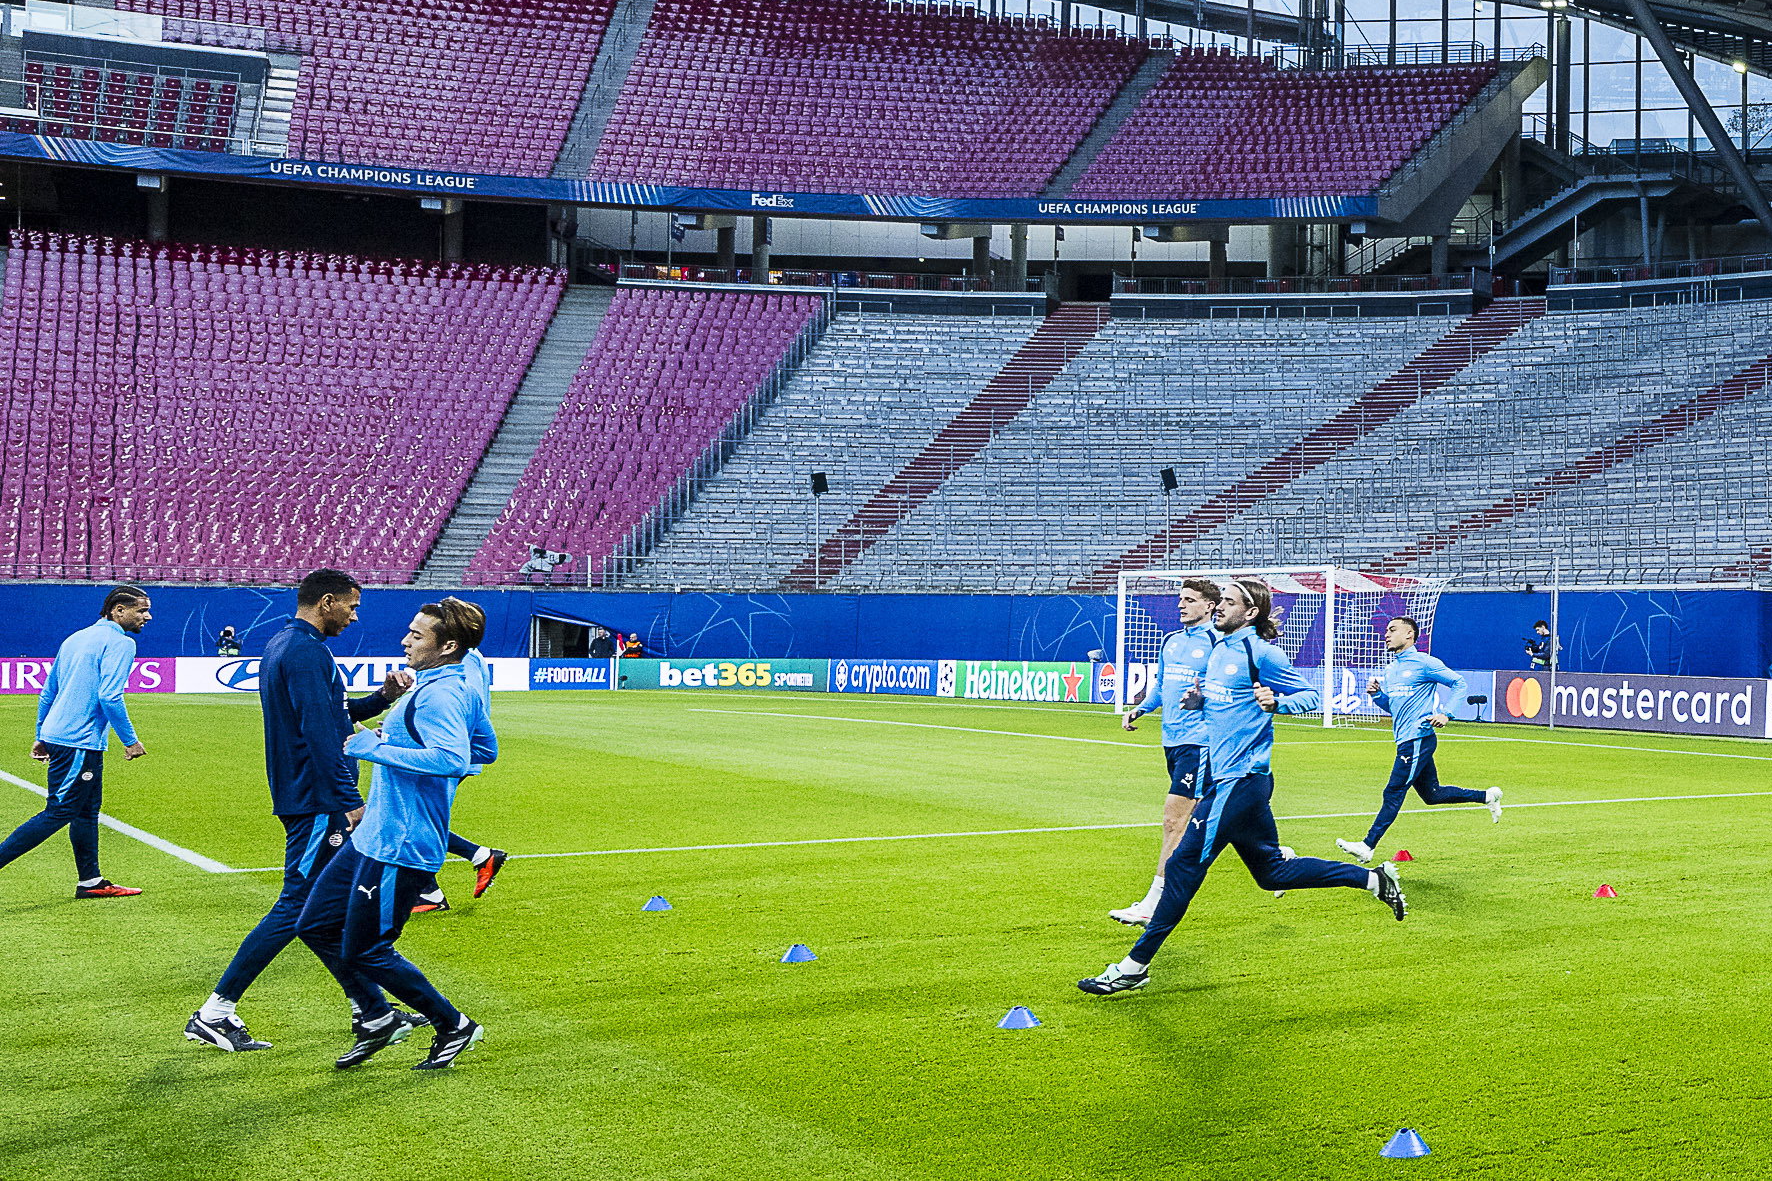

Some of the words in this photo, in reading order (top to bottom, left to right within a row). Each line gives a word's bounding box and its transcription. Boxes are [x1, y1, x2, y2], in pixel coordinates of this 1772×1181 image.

[270, 162, 313, 176] UEFA
[317, 166, 411, 184] CHAMPIONS
[417, 174, 476, 189] LEAGUE
[751, 193, 794, 208] FedEx
[1038, 203, 1072, 214] UEFA
[1074, 203, 1148, 215] CHAMPIONS
[1152, 203, 1198, 214] LEAGUE
[533, 667, 607, 683] #FOOTBALL
[659, 661, 772, 687] bet365
[851, 659, 930, 693] crypto.com
[964, 660, 1061, 702] Heineken
[1552, 680, 1752, 726] mastercard
